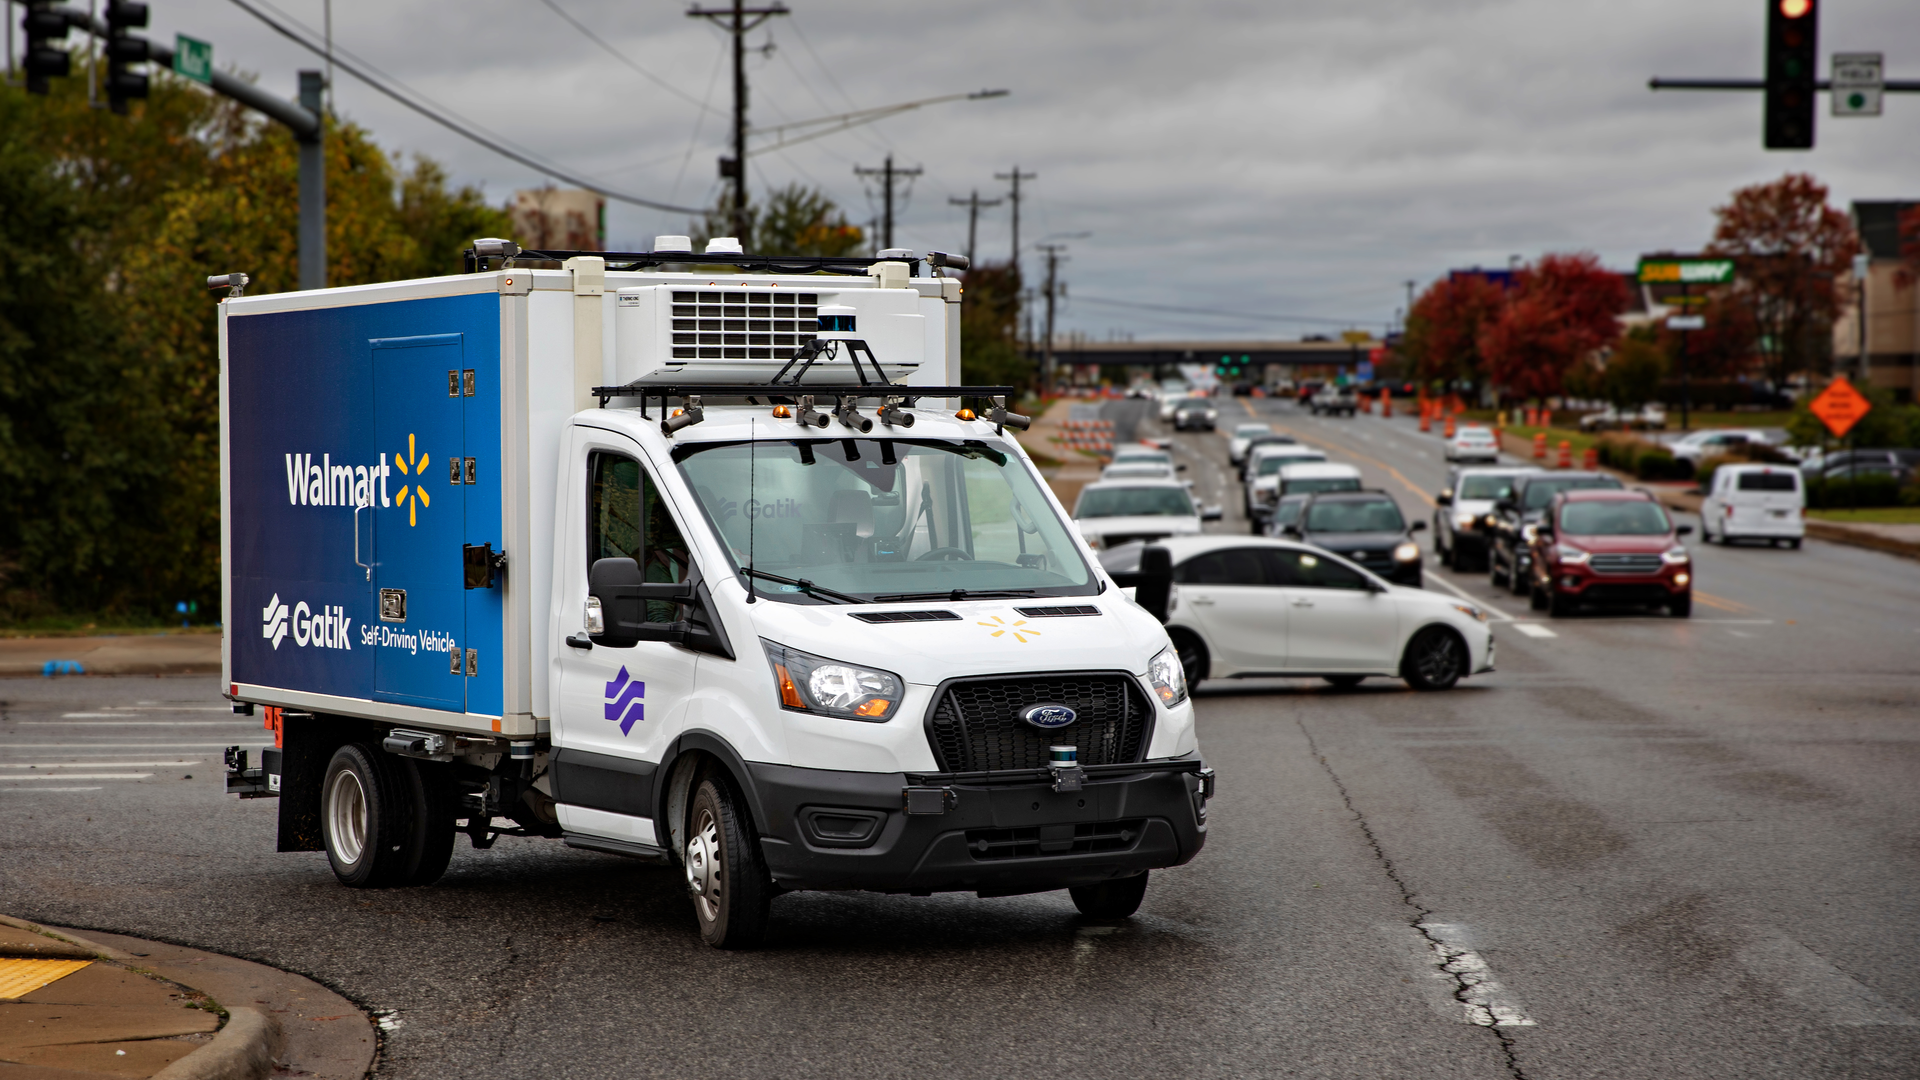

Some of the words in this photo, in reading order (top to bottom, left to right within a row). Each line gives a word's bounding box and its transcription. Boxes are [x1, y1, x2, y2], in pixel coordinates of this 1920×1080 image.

[1639, 261, 1733, 282] SUBWAY
[285, 452, 391, 508] Walmart
[743, 498, 803, 520] Gatik
[293, 600, 352, 651] Gatik
[361, 624, 418, 656] Self-Driving
[419, 629, 456, 653] Vehicle
[1039, 708, 1068, 724] Ford
